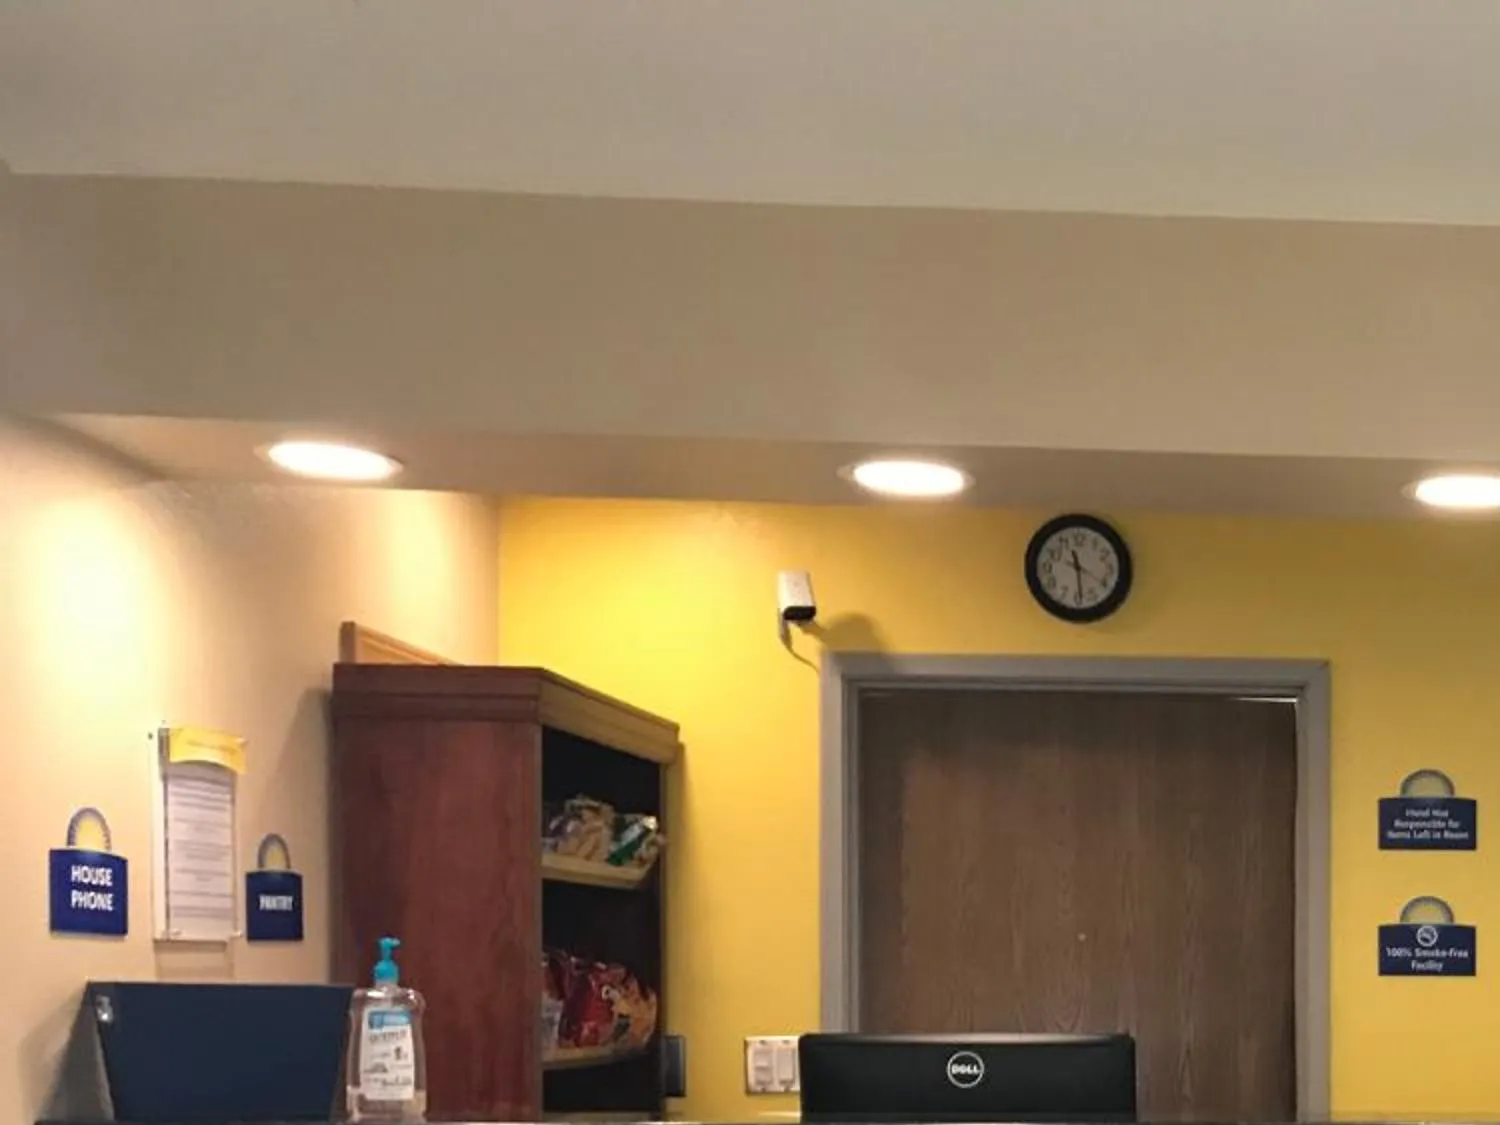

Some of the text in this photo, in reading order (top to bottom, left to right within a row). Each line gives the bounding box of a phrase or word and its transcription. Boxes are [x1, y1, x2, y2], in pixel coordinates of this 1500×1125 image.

[71, 864, 113, 887] HOUSE
[71, 889, 114, 911] PHONE
[258, 894, 294, 911] PANTRY
[1386, 946, 1413, 958] 100%
[1411, 959, 1444, 973] Facility
[951, 1063, 980, 1075] DELL
